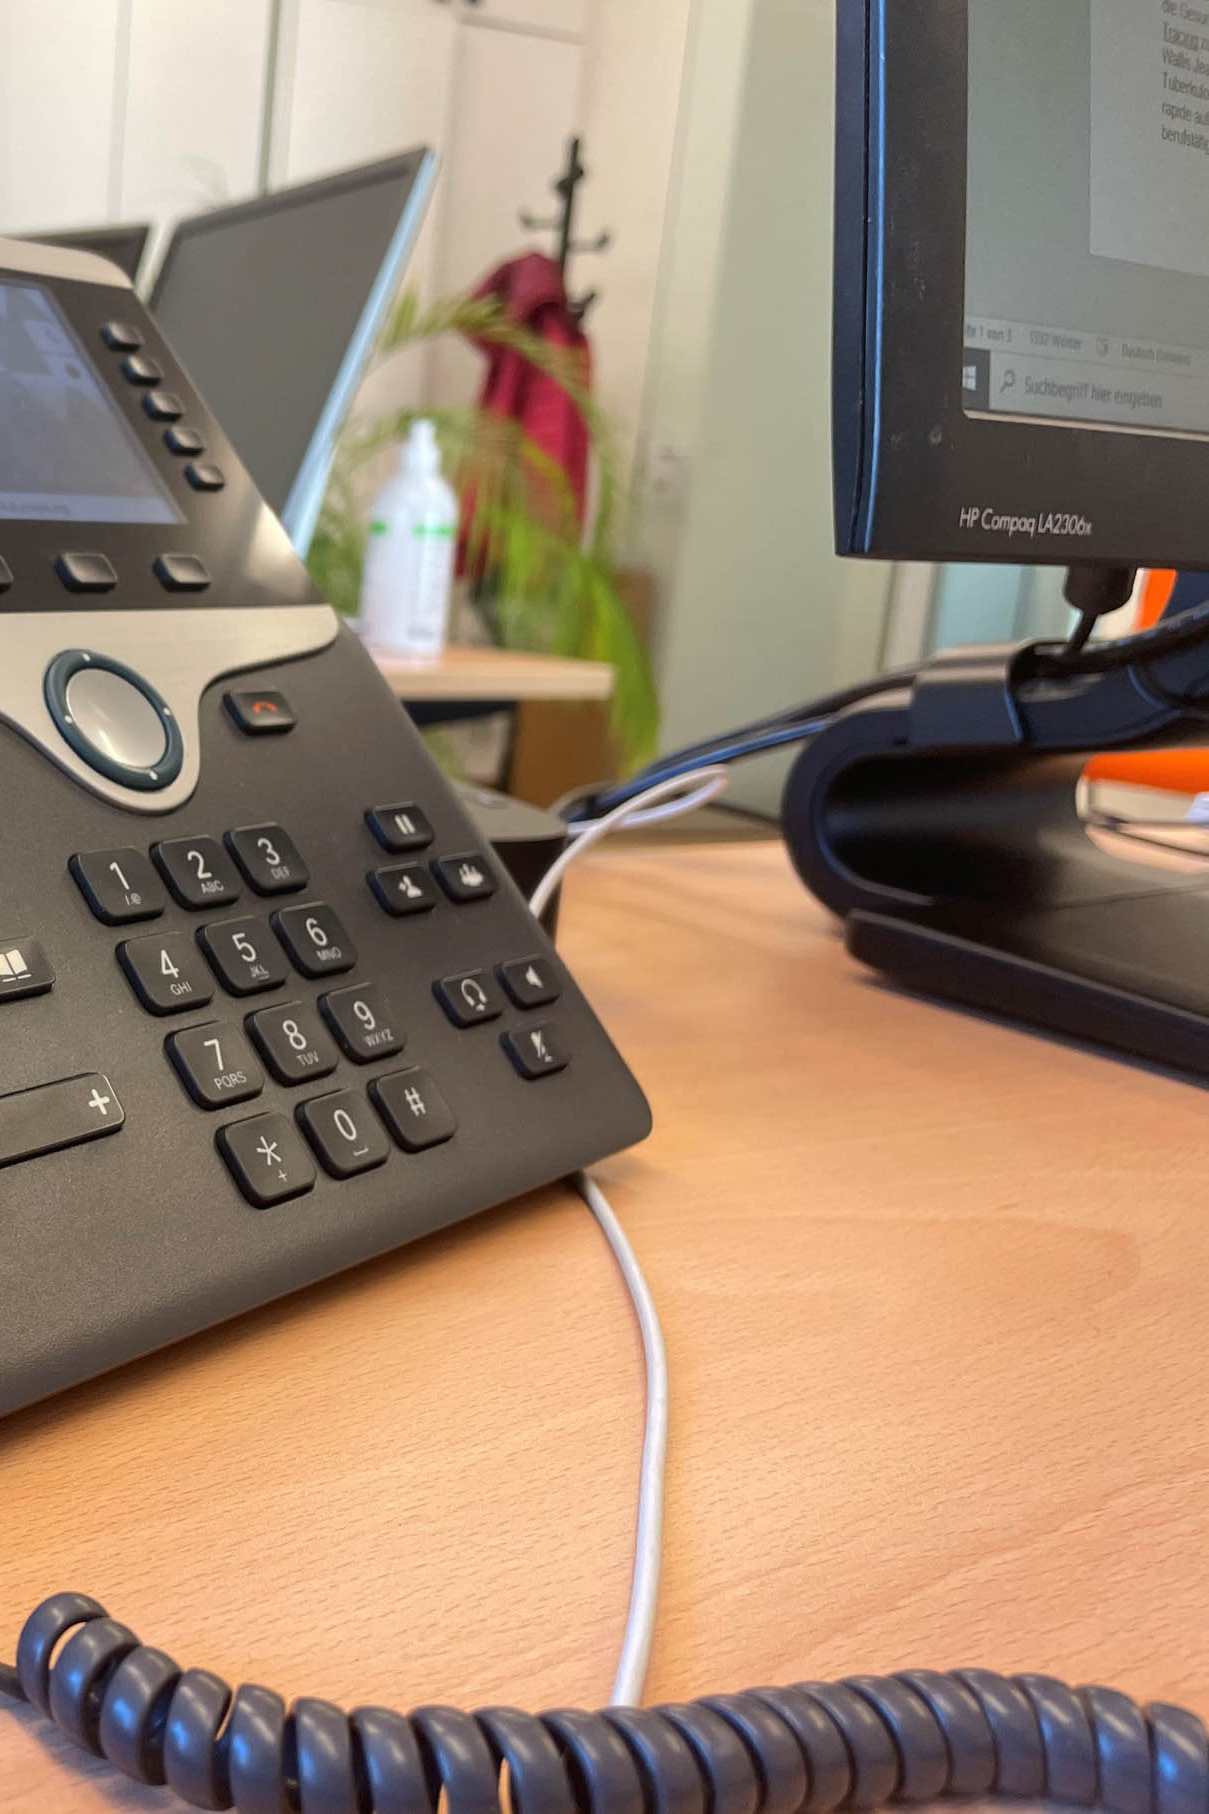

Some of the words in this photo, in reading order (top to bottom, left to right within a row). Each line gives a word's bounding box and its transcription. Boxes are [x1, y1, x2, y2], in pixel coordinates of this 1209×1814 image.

[1024, 376, 1088, 402] Suchbegriff
[1091, 383, 1111, 402] hier
[959, 507, 979, 528] HP
[981, 508, 1036, 537] Compaq
[1037, 512, 1092, 536] LA2306x
[187, 851, 212, 879] 2
[257, 838, 280, 865] 3
[110, 862, 130, 890] 1
[201, 880, 225, 894] ABC
[305, 917, 328, 947] 6
[232, 933, 257, 962] 5
[316, 947, 342, 961] MNO
[160, 949, 180, 979] 4
[170, 981, 192, 996] GHI
[353, 1000, 376, 1030] 9
[282, 1019, 307, 1050] 8
[203, 1038, 224, 1071] 7
[296, 1051, 319, 1067] TUV
[213, 1070, 247, 1091] PQRS
[404, 1086, 426, 1117] #
[333, 1109, 357, 1141] 0
